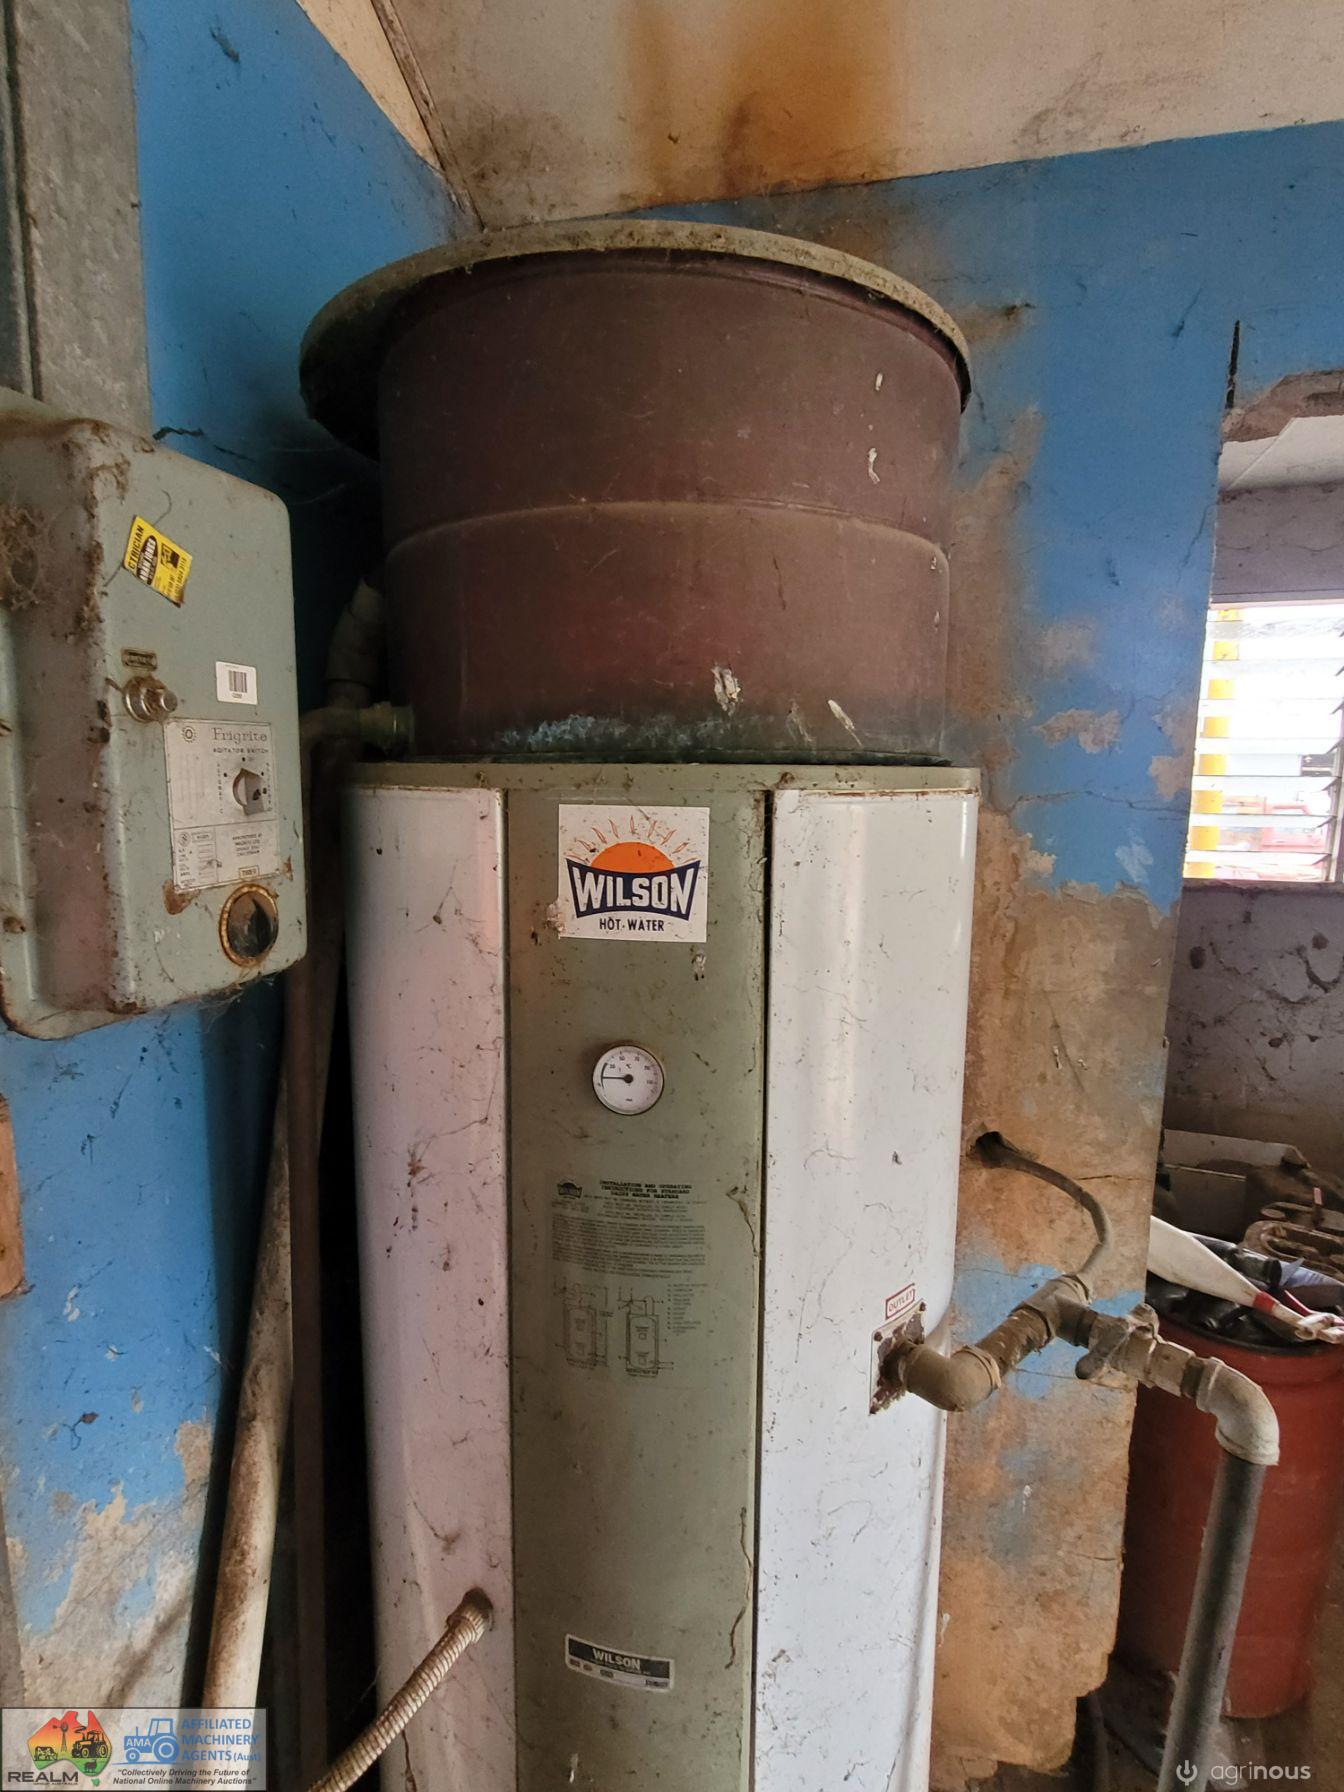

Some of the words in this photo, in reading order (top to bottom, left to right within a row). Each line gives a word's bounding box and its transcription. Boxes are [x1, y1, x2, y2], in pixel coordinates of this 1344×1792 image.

[211, 727, 268, 744] Frigrite
[572, 866, 694, 915] WILSON
[599, 918, 621, 931] HOT
[628, 918, 665, 932] WATER
[888, 1290, 912, 1312] OUTLET
[592, 1647, 641, 1671] WILSON
